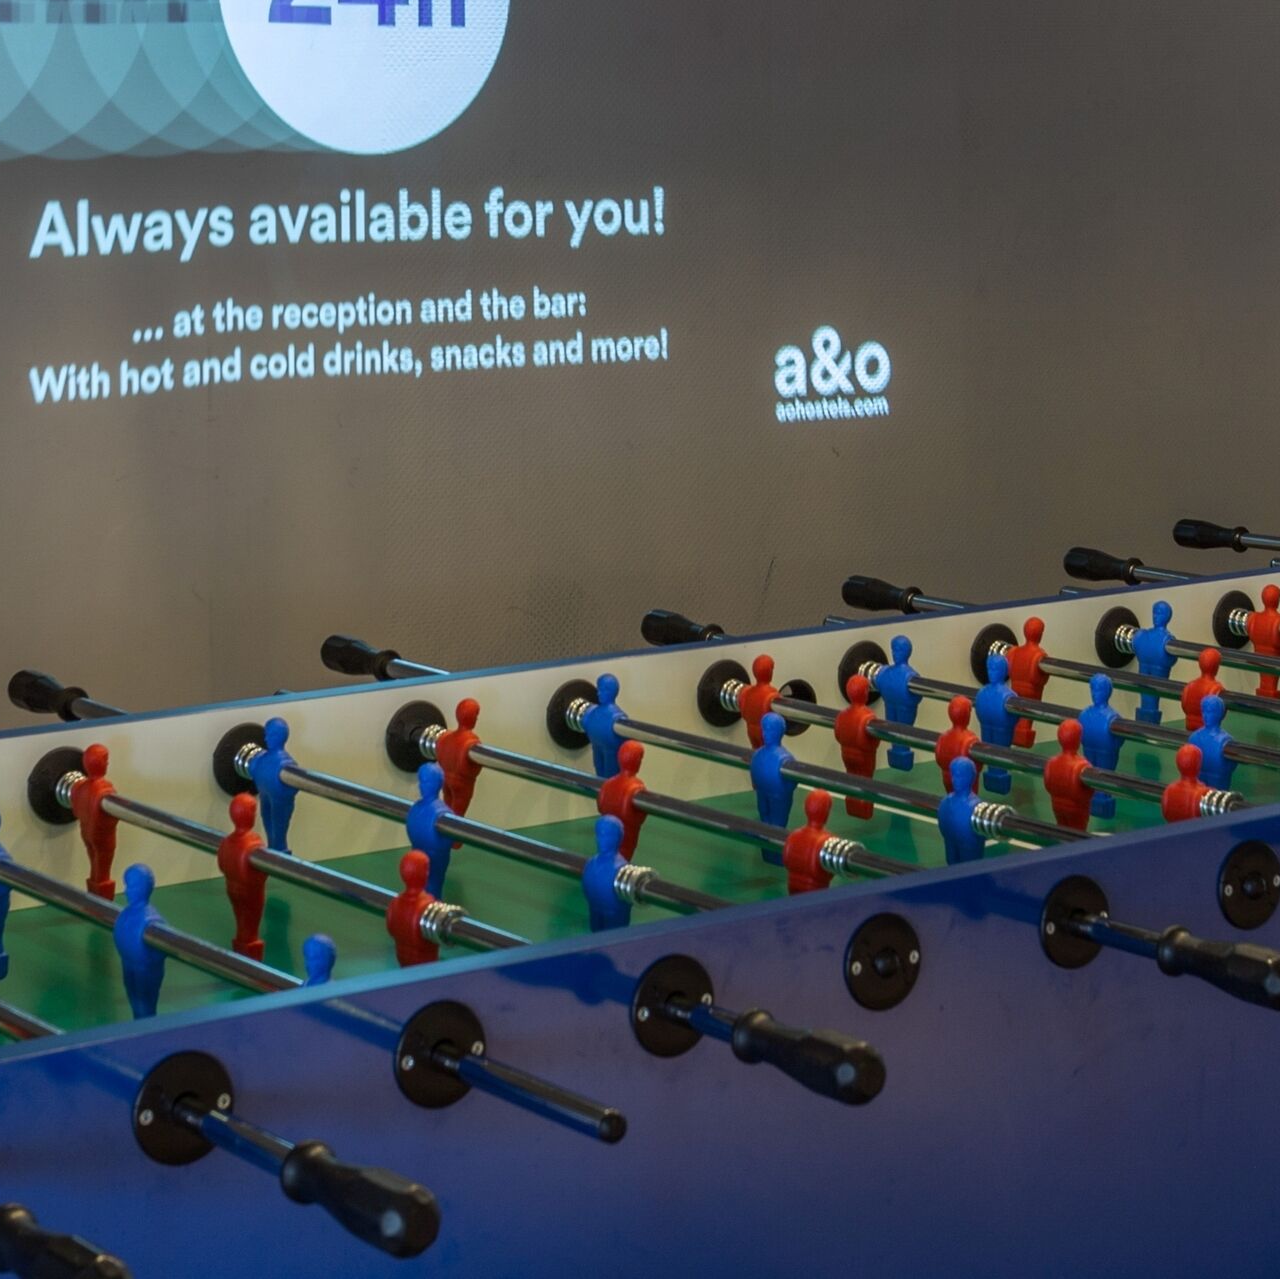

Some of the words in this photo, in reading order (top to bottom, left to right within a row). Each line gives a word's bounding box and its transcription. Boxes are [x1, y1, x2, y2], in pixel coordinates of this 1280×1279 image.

[29, 198, 235, 263] Always
[249, 187, 473, 245] available
[484, 185, 554, 239] for
[564, 185, 666, 249] you!
[173, 303, 205, 339] at
[212, 297, 264, 333] the
[272, 291, 413, 335] reception
[420, 288, 473, 324] and
[479, 287, 526, 321] the
[533, 285, 587, 320] bar:
[29, 362, 111, 405] With
[120, 357, 174, 397] hot
[182, 345, 242, 388] and
[250, 342, 315, 380] cold
[322, 338, 423, 378] drinks,
[430, 333, 526, 372] snacks
[533, 328, 584, 367] and
[591, 327, 668, 363] more!
[774, 325, 892, 399] a&o
